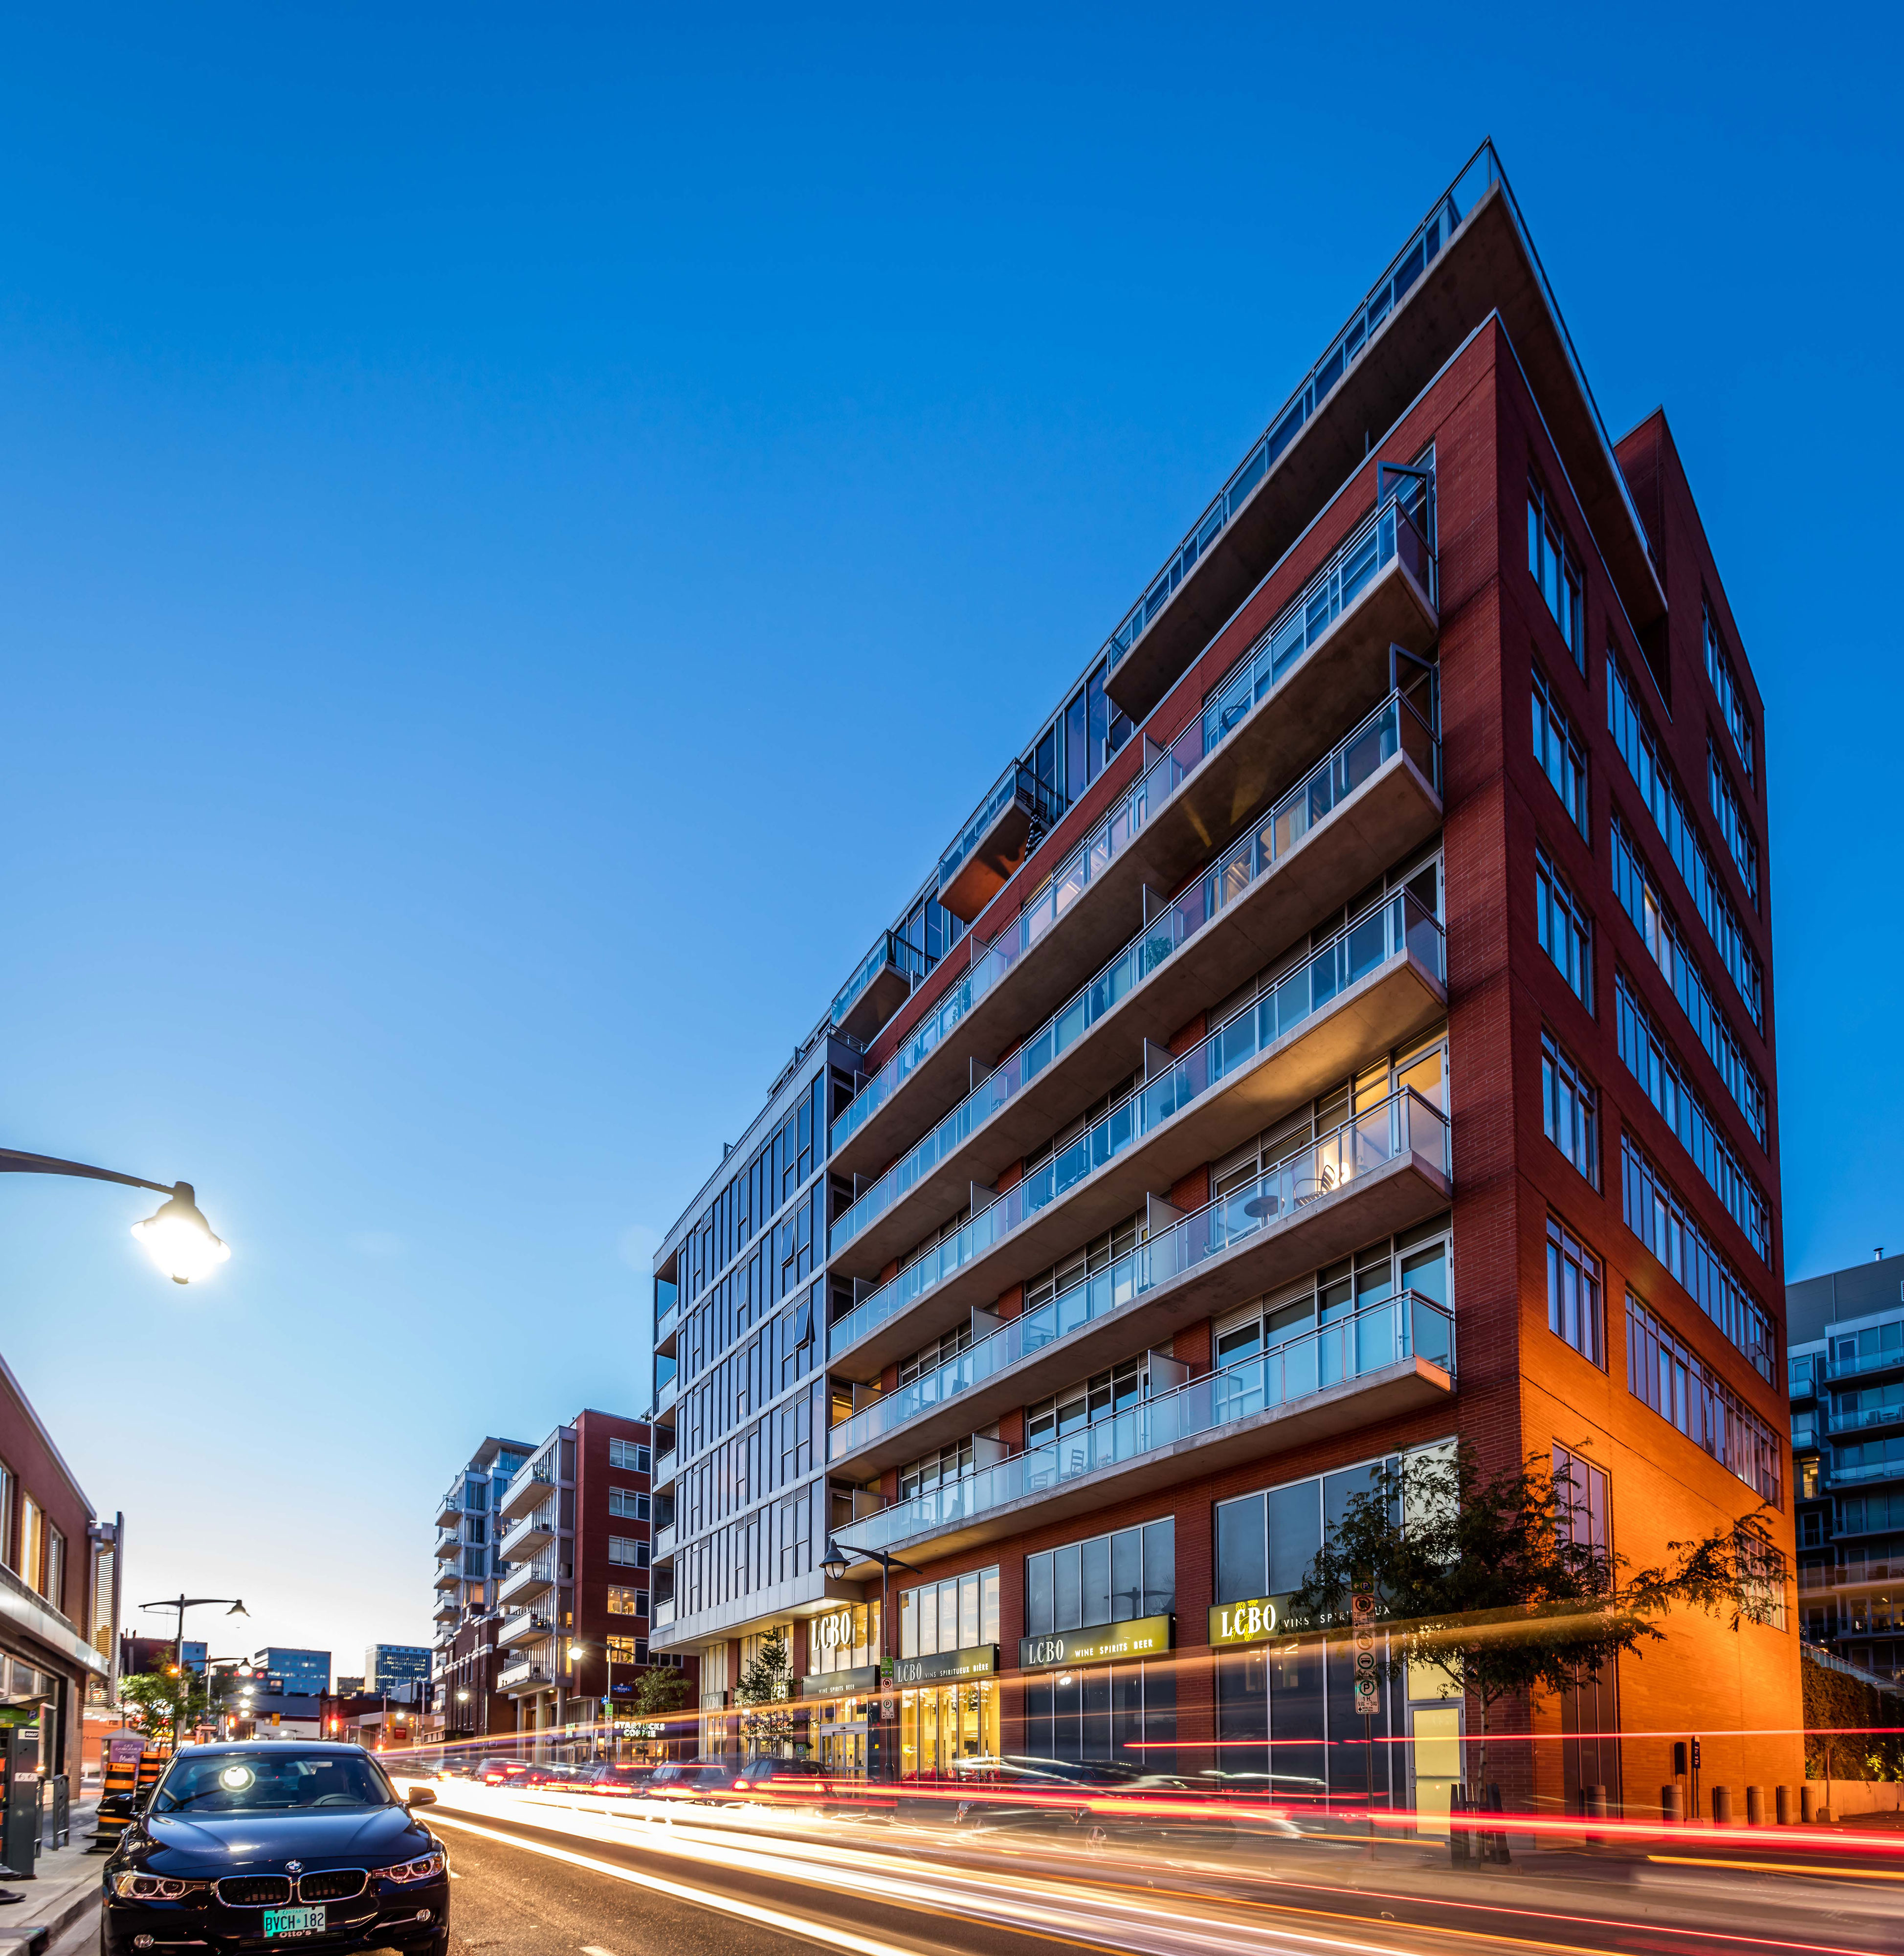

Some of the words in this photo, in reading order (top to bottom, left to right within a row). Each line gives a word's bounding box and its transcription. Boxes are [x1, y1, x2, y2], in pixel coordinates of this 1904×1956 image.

[1221, 1604, 1276, 1637] LCBO
[1284, 1617, 1309, 1628] VINS
[811, 1612, 851, 1651] LCBO
[1029, 1640, 1064, 1664] LCBO
[1075, 1648, 1093, 1658] WINE
[1100, 1643, 1128, 1655] SPIRITS
[1133, 1639, 1153, 1649] BEER
[898, 1663, 922, 1683] LCBO
[940, 1667, 969, 1676] SPIRITUEUX
[973, 1663, 988, 1672] BIÈRE
[706, 1696, 719, 1710] LCBO
[266, 1914, 295, 1932] BVCH
[304, 1912, 324, 1928] 182
[279, 1930, 311, 1938] Otto's
